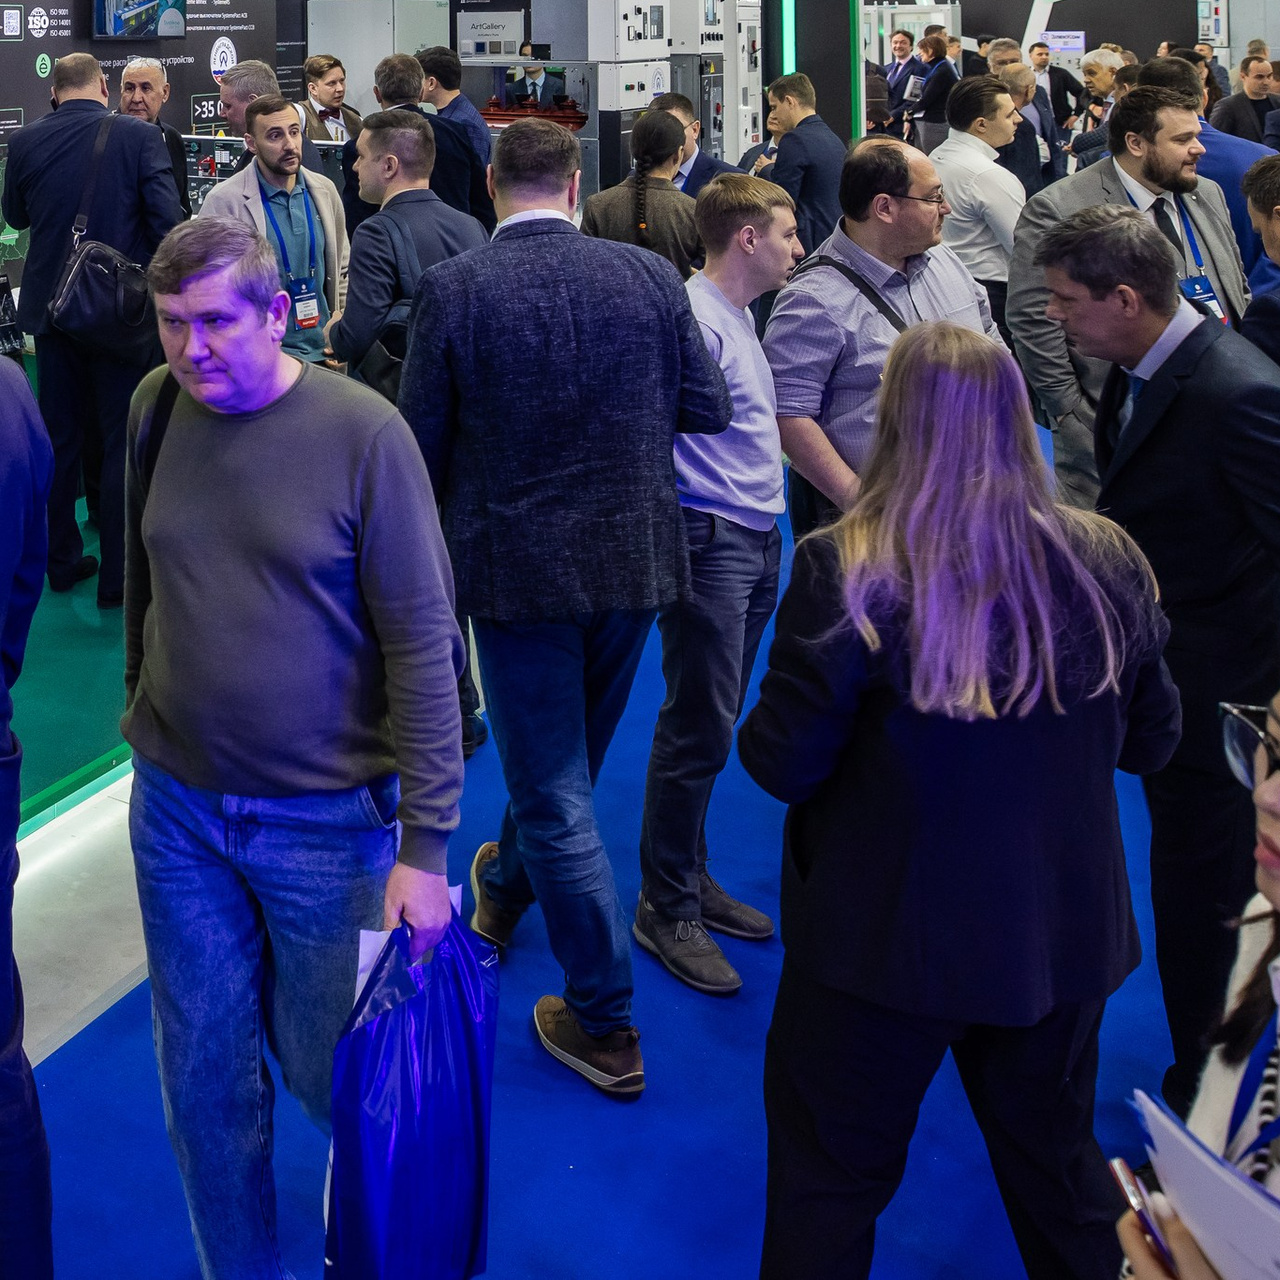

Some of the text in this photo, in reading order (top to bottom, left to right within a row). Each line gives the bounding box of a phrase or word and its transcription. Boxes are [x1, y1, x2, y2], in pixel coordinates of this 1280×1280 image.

[28, 15, 50, 29] ISO
[470, 22, 506, 31] ArtGallery
[166, 55, 195, 65] устройство
